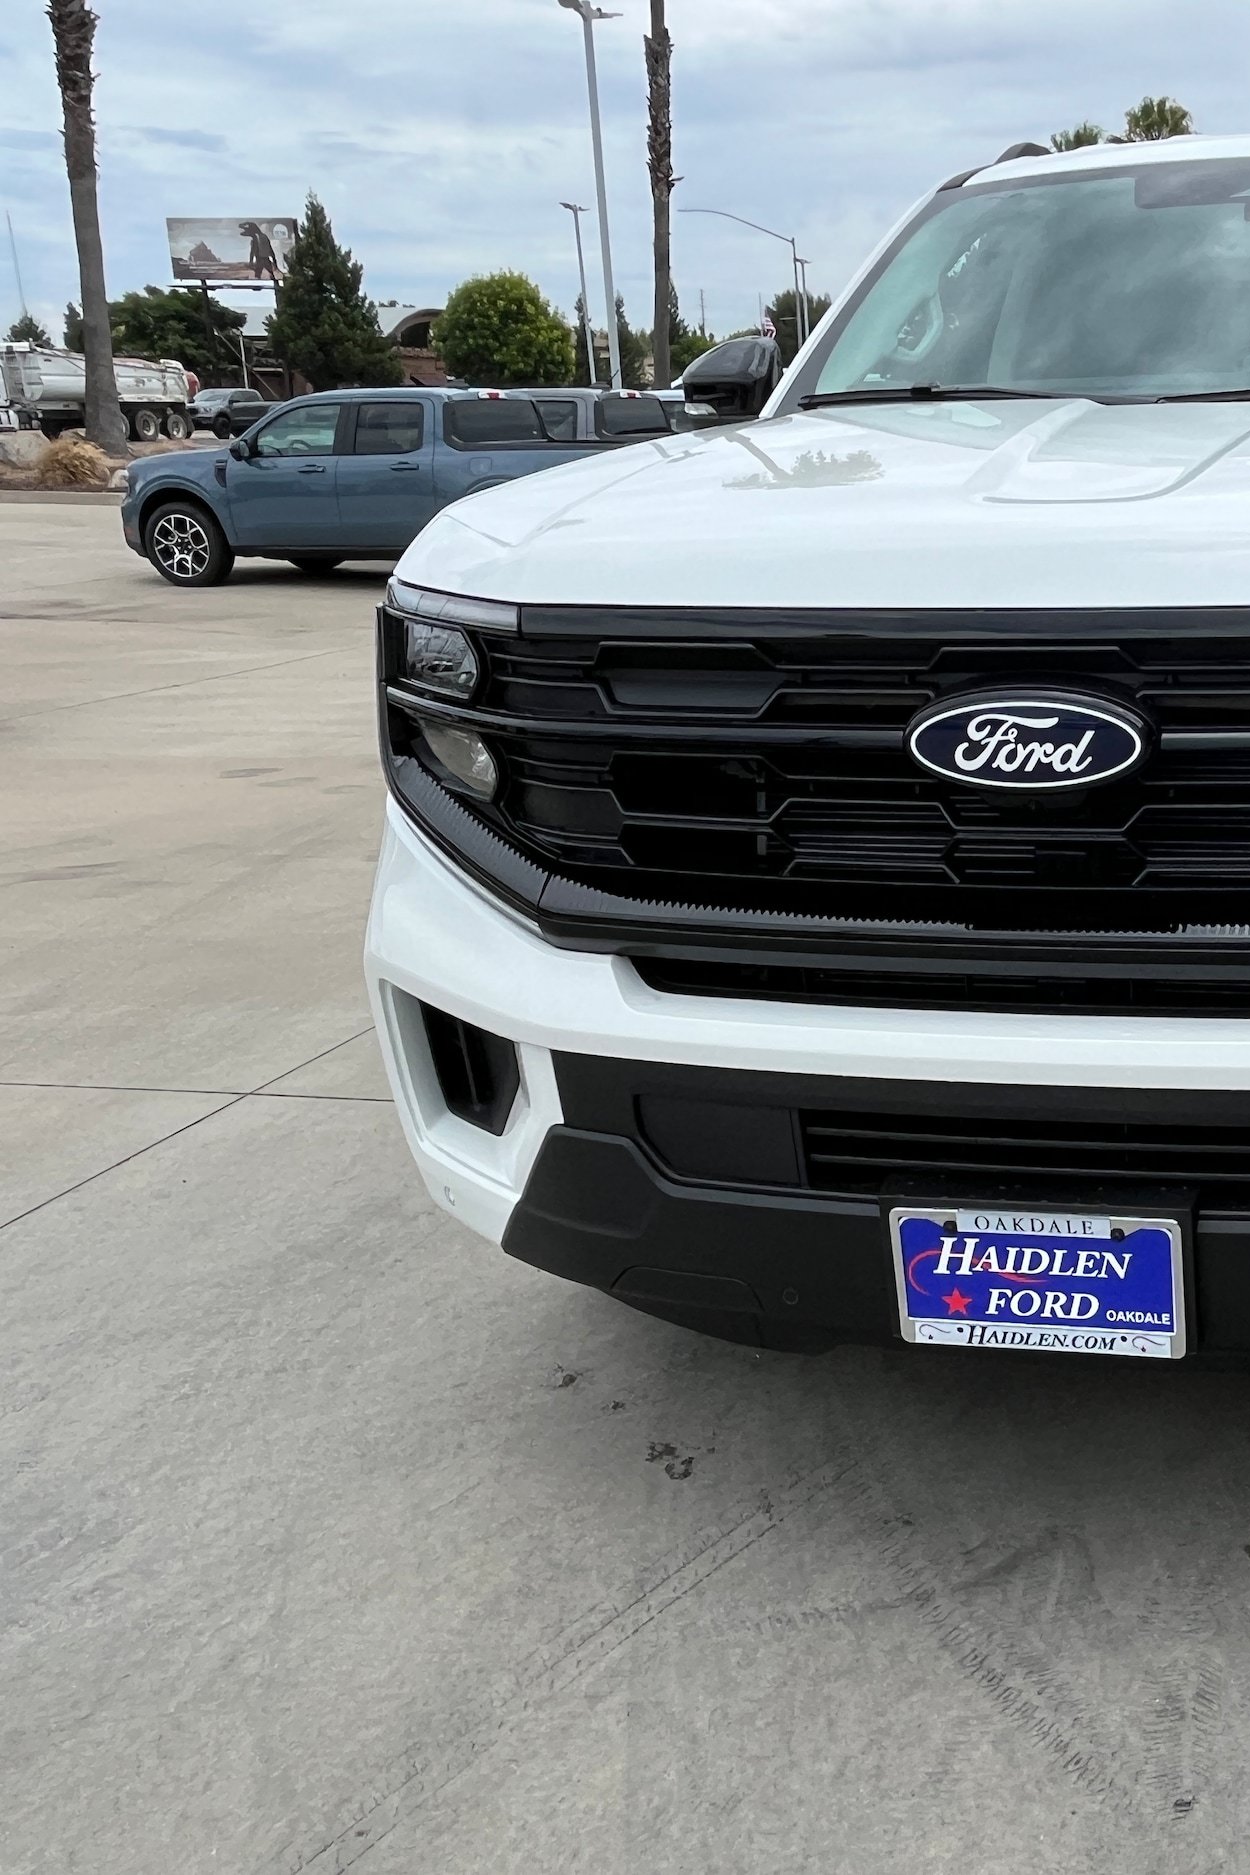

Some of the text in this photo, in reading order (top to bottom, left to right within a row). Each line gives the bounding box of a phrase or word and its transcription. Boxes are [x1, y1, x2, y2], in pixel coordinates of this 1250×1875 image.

[954, 713, 1095, 773] Ford
[974, 1215, 1094, 1235] OAKDALE
[933, 1237, 1133, 1280] HAIDLEN
[985, 1288, 1100, 1320] FORD
[1106, 1309, 1171, 1325] OAKDALE
[967, 1324, 1117, 1351] HAIDLEN.COM
